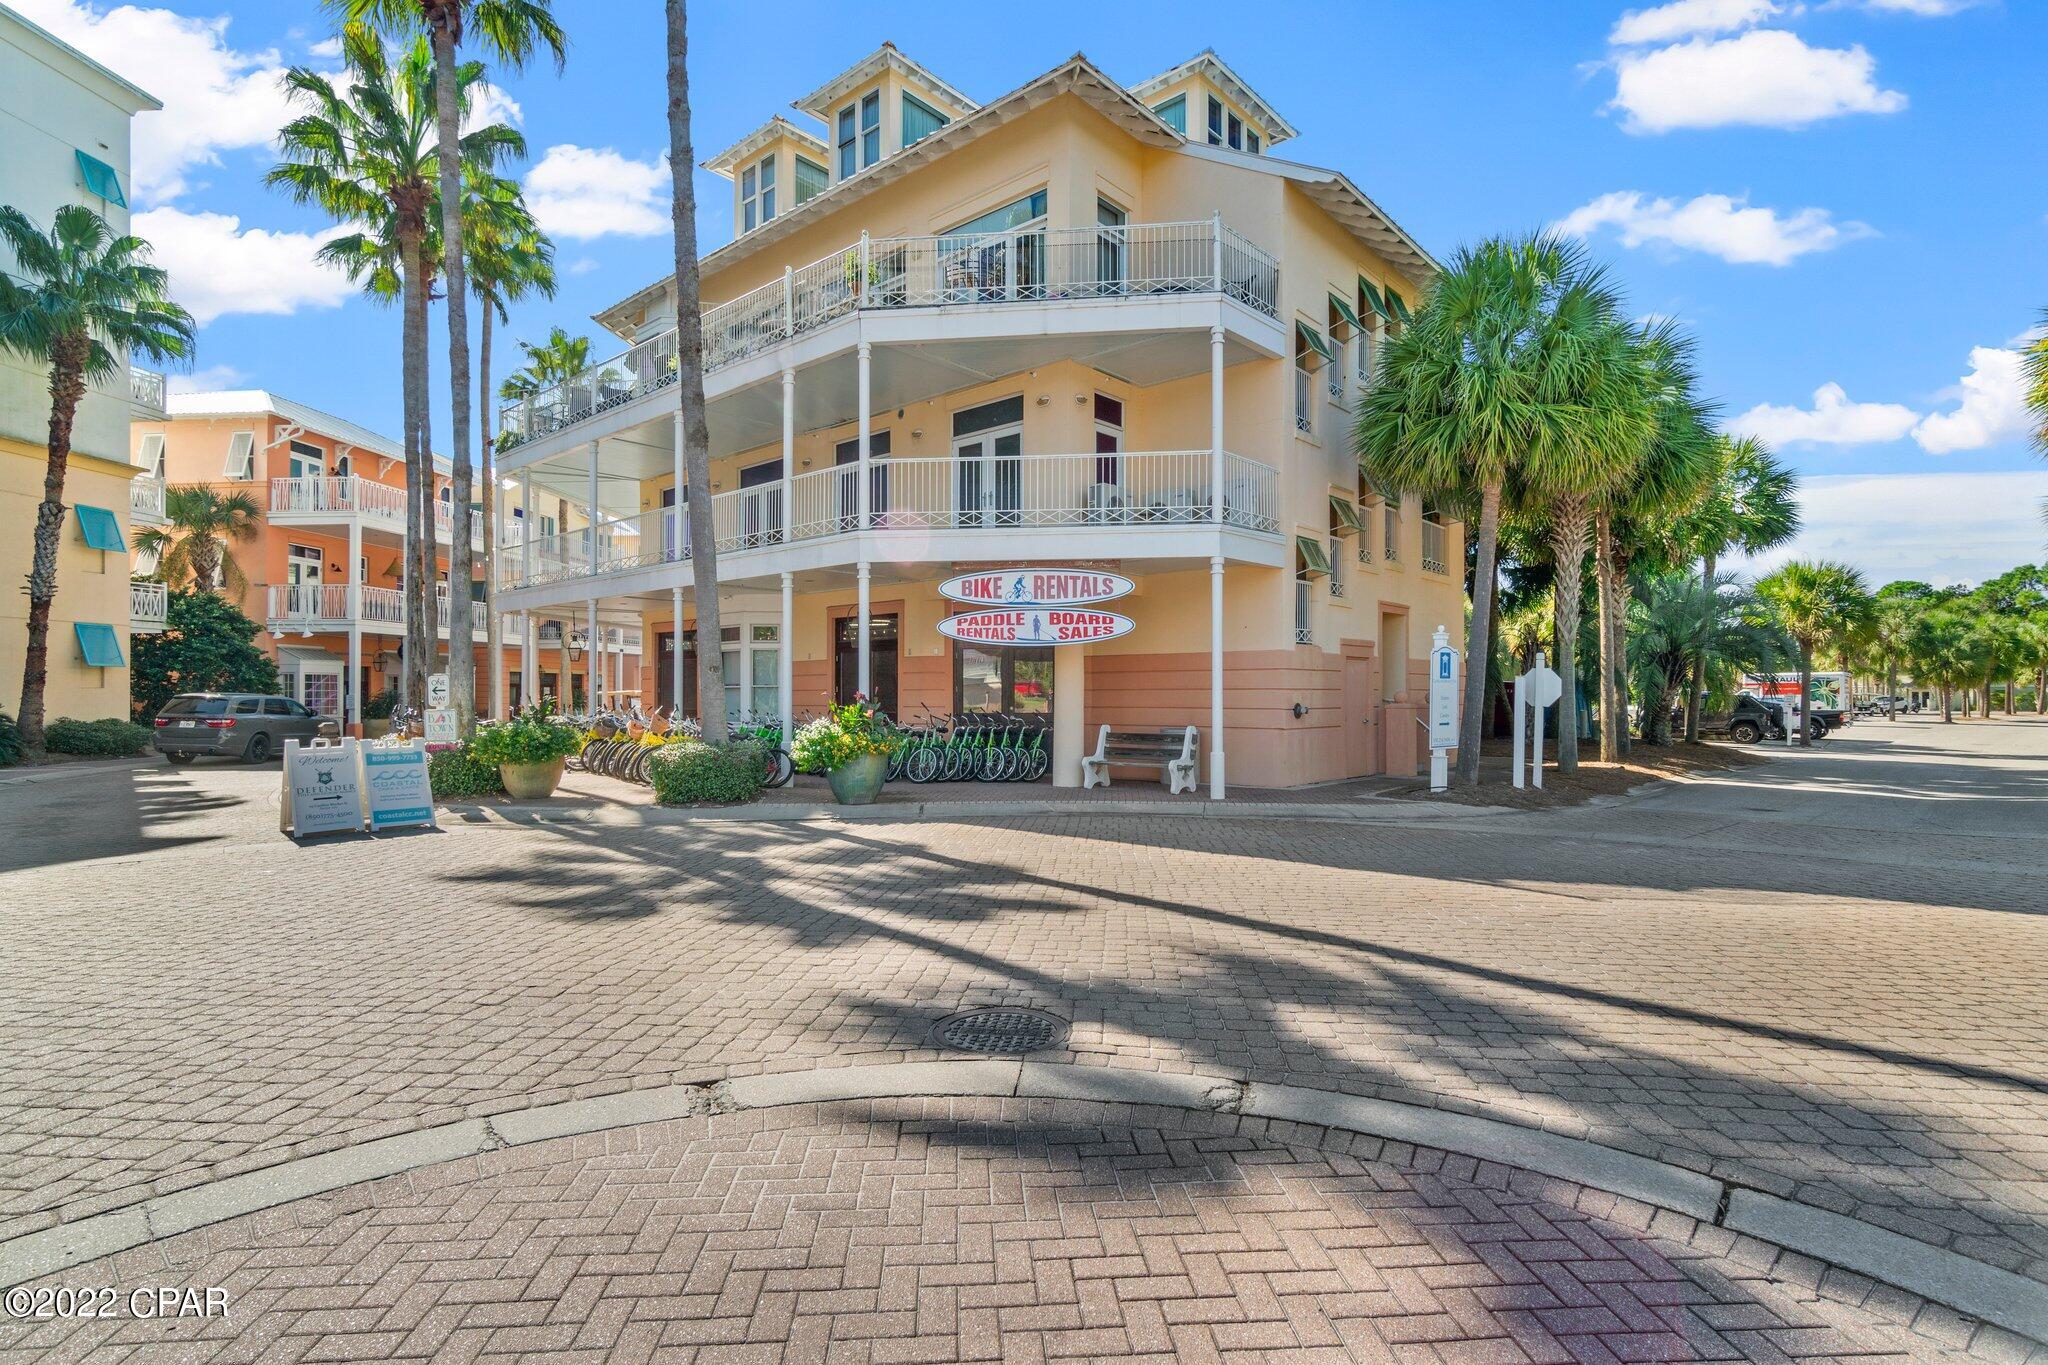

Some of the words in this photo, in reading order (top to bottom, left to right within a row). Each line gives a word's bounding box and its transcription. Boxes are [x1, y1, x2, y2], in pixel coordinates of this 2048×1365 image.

[961, 576, 1003, 598] BIKE
[1033, 574, 1114, 600] RENTALS
[956, 612, 1026, 627] PADDLE
[1049, 612, 1114, 626] BOARD
[956, 627, 1016, 641] RENTALS
[1058, 626, 1114, 641] SALES
[298, 755, 350, 766] Welcome!
[296, 783, 356, 795] DEFENDER
[372, 779, 423, 788] COASTAL
